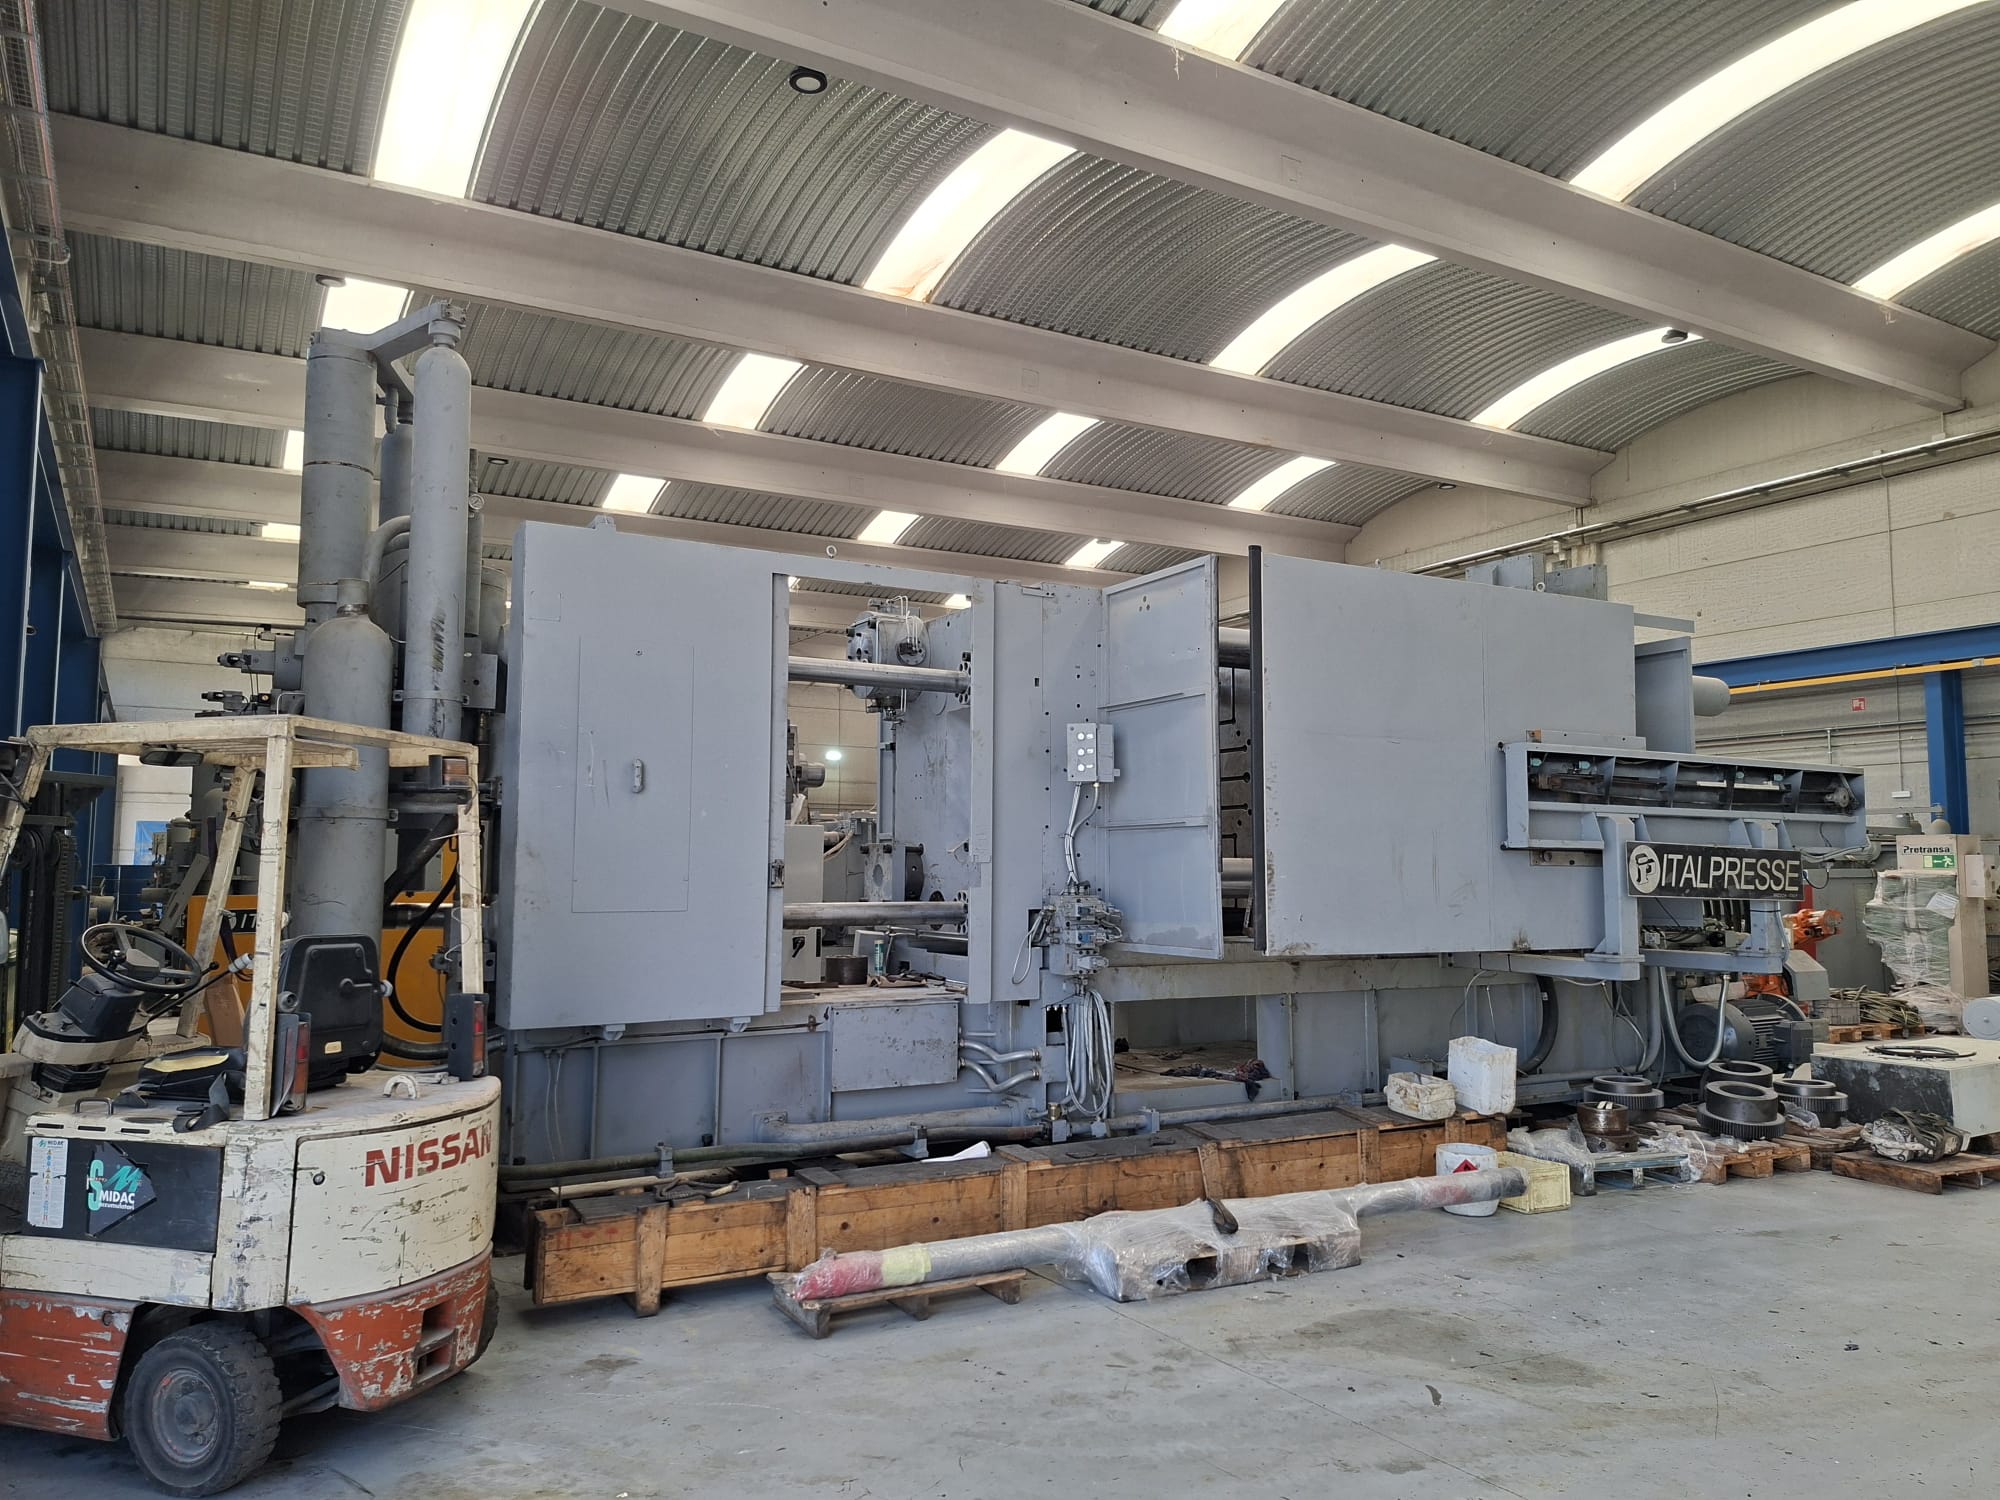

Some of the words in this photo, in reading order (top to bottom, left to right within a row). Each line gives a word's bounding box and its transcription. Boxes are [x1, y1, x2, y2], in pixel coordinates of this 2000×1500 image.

[1903, 845, 1950, 854] Pretransa
[1661, 853, 1800, 892] ITALPRESSE
[365, 1119, 492, 1187] NISSAN
[99, 1190, 135, 1204] MIDAC
